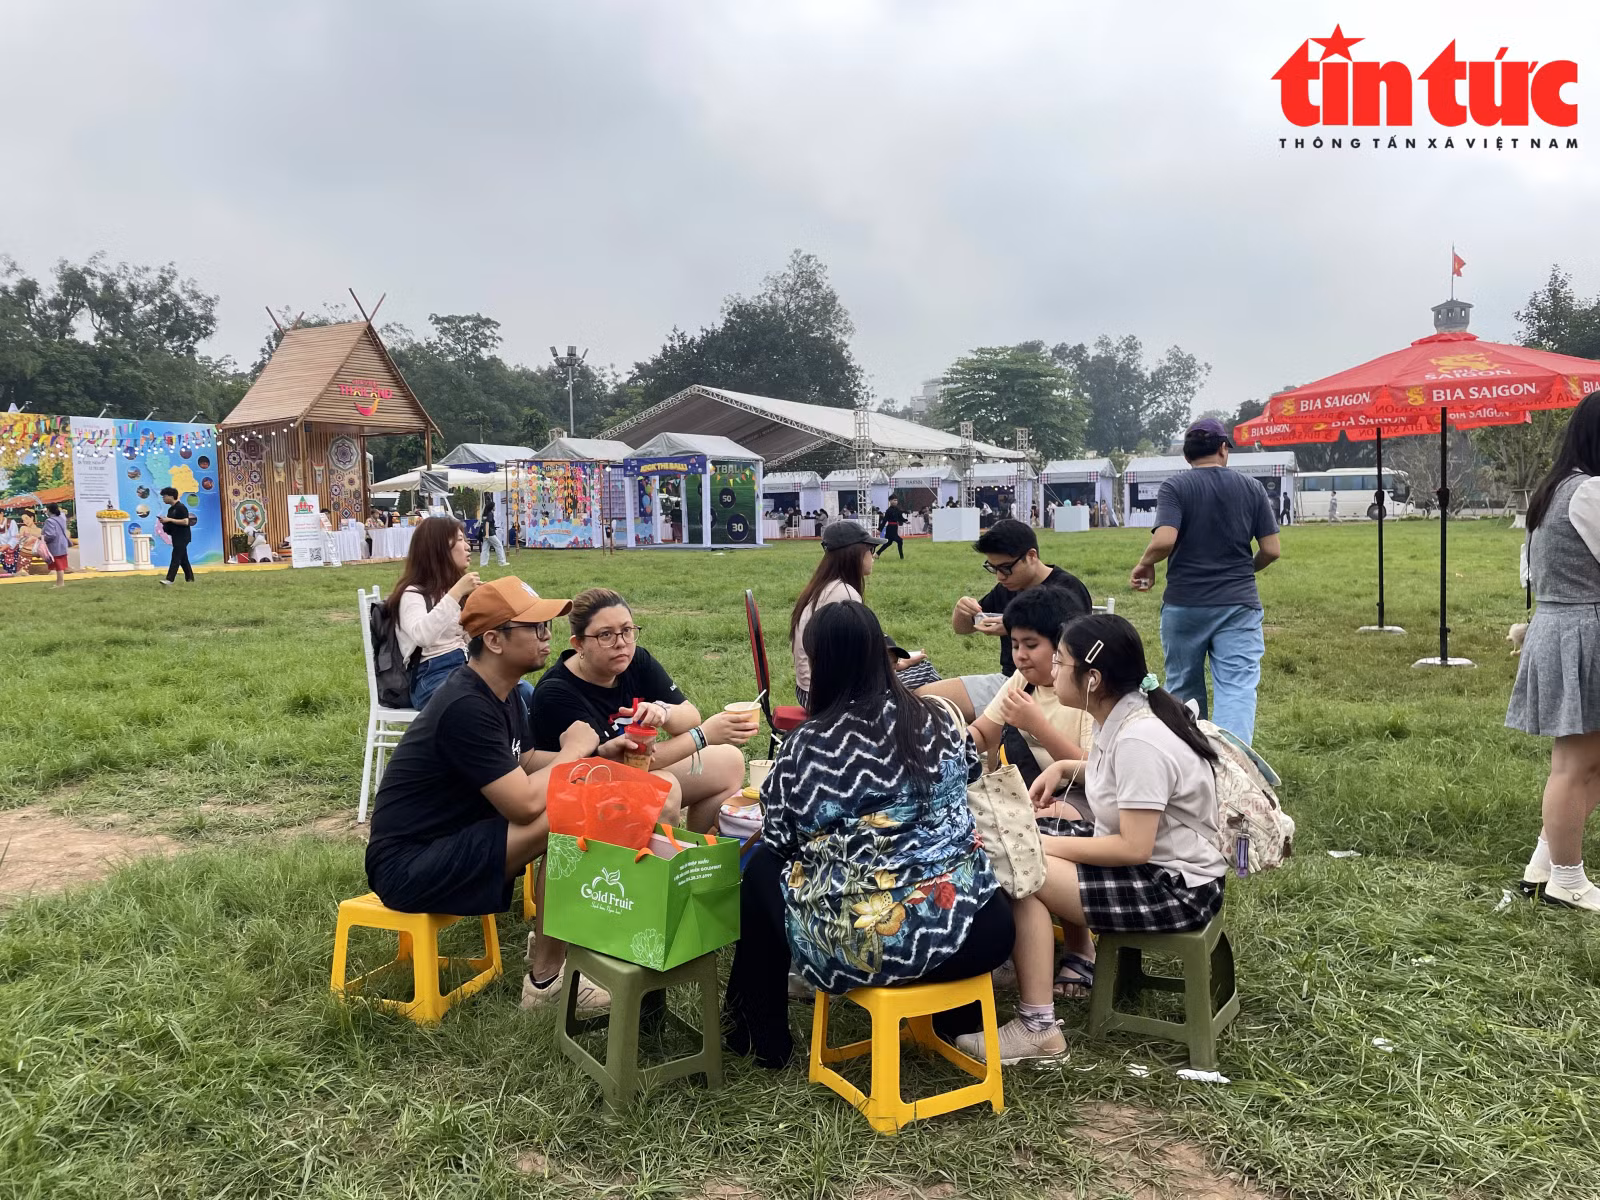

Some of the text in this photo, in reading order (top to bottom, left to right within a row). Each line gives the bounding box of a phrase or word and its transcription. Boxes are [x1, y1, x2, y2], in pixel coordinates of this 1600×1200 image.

[338, 384, 393, 400] THAILAND
[1432, 382, 1537, 402] BIA SAIGON
[1300, 392, 1371, 412] BIA SAIGON
[1251, 423, 1290, 437] BIA SAIGON
[722, 495, 732, 503] 50
[731, 523, 744, 532] 30
[580, 883, 635, 911] Gold Fruit
